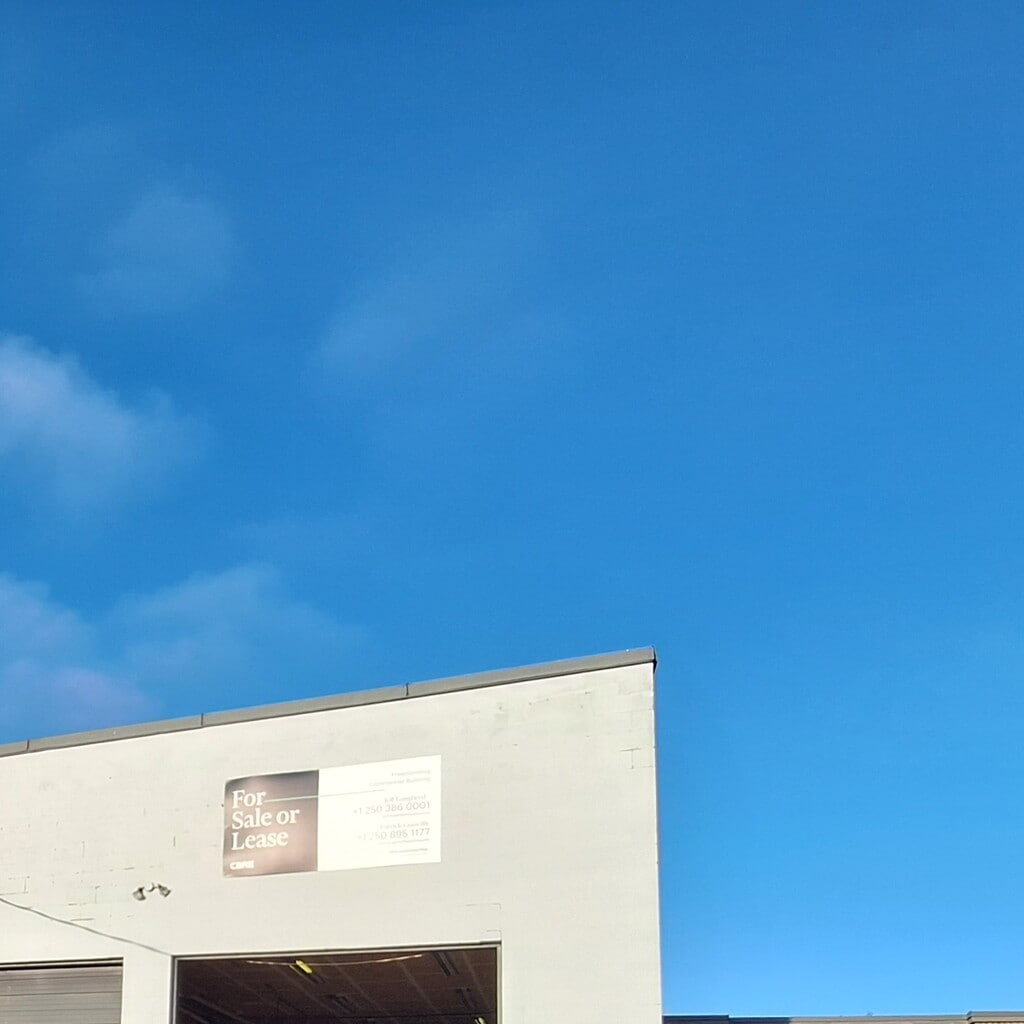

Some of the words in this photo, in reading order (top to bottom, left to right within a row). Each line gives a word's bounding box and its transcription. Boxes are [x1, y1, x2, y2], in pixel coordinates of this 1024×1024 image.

[232, 789, 266, 809] For
[385, 803, 403, 812] 386
[406, 801, 430, 811] 0001
[231, 808, 273, 830] Sale
[276, 809, 300, 825] or
[231, 831, 288, 850] Lease
[411, 827, 430, 837] 1177
